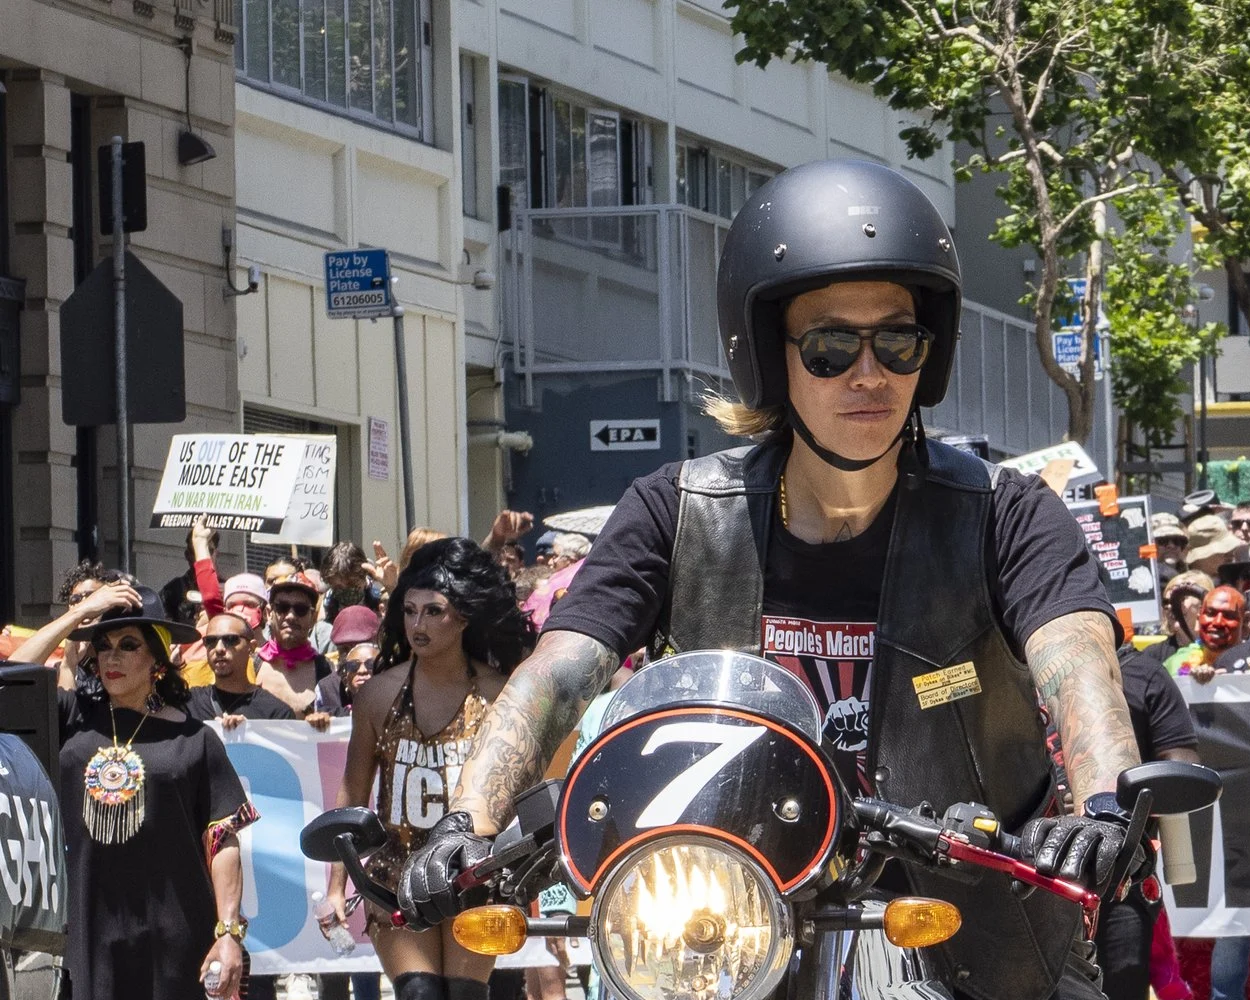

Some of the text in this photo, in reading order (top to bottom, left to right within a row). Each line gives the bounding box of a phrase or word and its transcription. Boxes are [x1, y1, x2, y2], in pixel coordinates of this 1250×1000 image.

[328, 253, 369, 269] Pay by
[329, 267, 373, 279] License
[329, 280, 360, 291] Plate
[333, 294, 383, 306] 61206005
[1057, 336, 1073, 346] Pay
[609, 428, 645, 441] EPA
[180, 440, 285, 466] US OUT OF THE
[178, 464, 268, 488] MIDDLE EAST
[171, 492, 263, 512] NO WAR WITH IRAN
[160, 514, 191, 527] FREEDOM
[233, 517, 264, 531] PARTY
[764, 624, 823, 656] People's
[921, 665, 966, 682] Patch Earned
[920, 691, 938, 701] Board
[635, 721, 768, 829] 7
